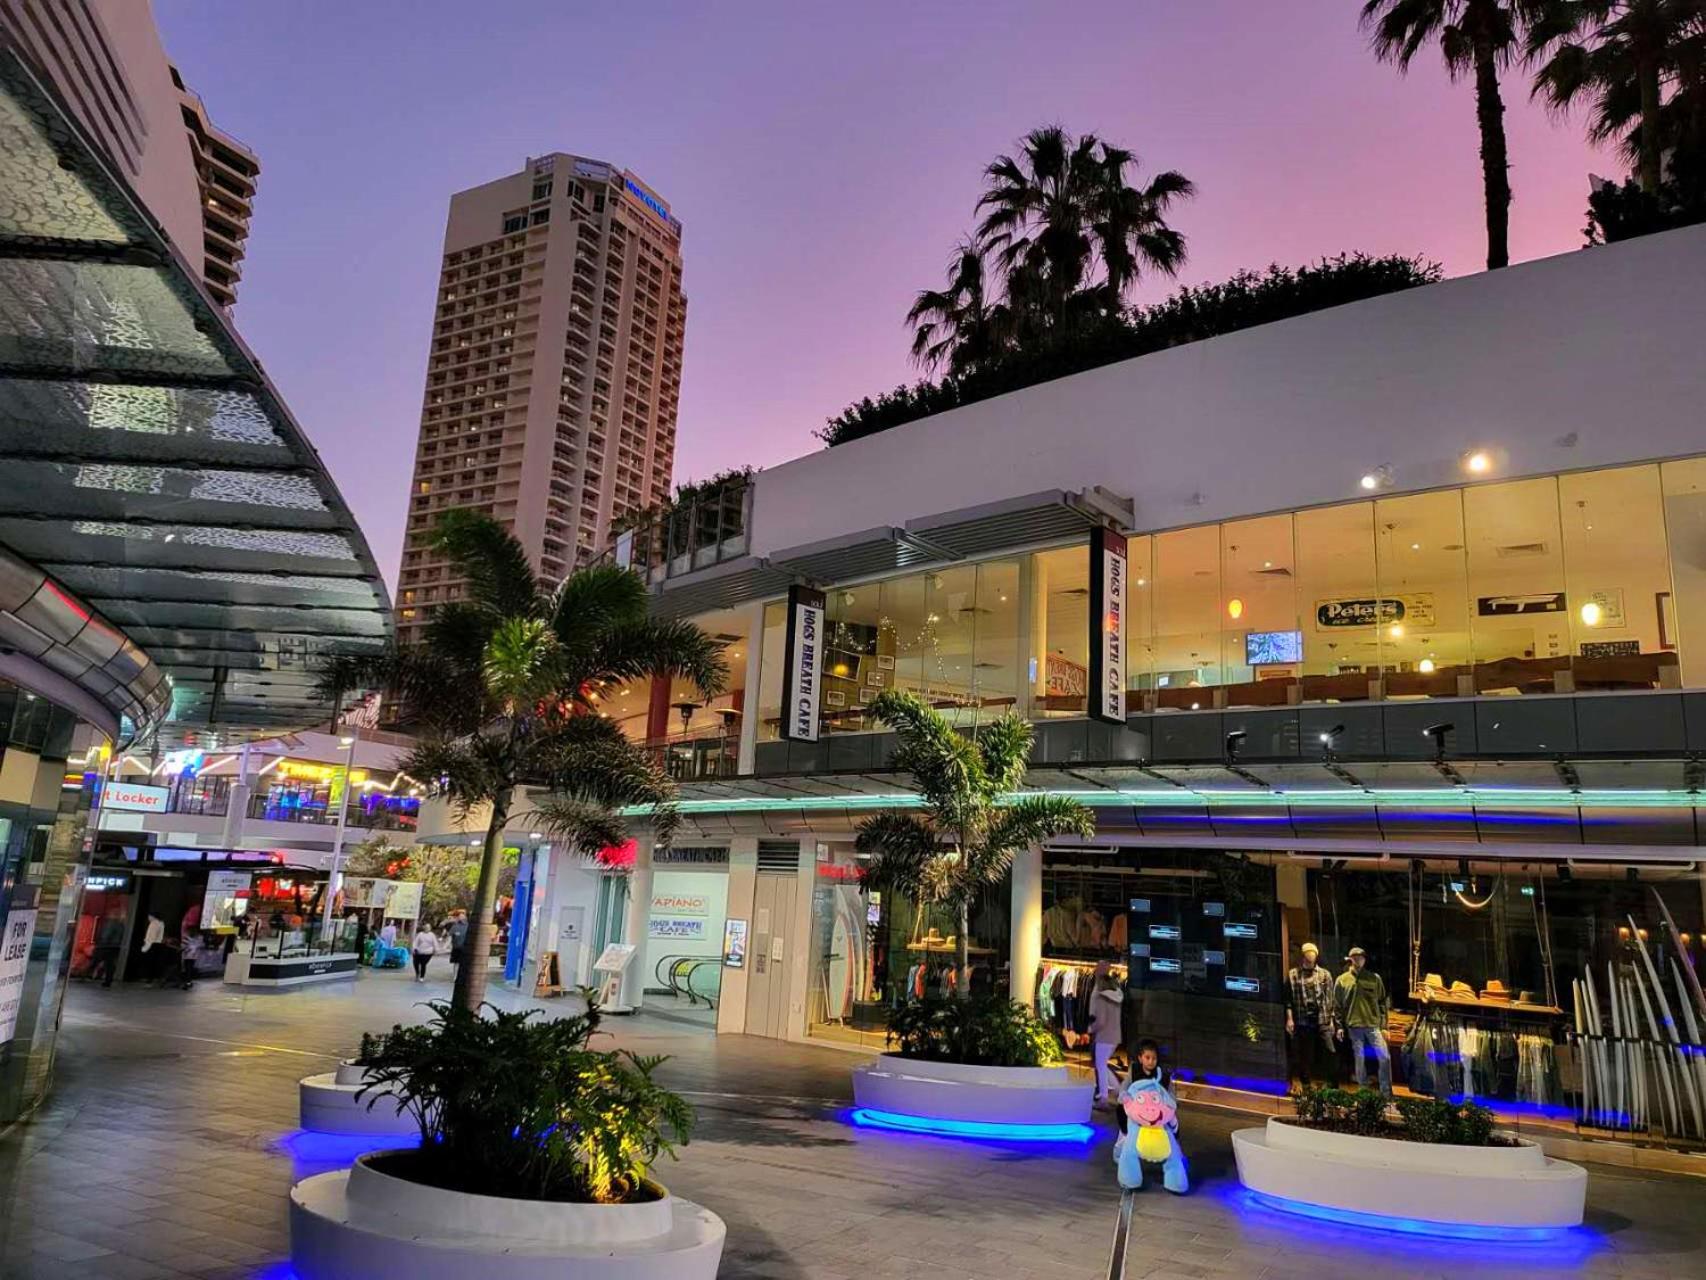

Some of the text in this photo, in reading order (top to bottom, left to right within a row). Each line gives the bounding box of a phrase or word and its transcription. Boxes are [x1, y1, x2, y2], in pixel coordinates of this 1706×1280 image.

[1110, 556, 1121, 597] HOGS
[1109, 600, 1121, 665] BREATH
[797, 608, 816, 738] HOGS BREATH CAFE
[1108, 667, 1120, 717] CAFE
[115, 790, 159, 806] Locker
[12, 922, 27, 938] FOR
[4, 943, 27, 963] LEASE
